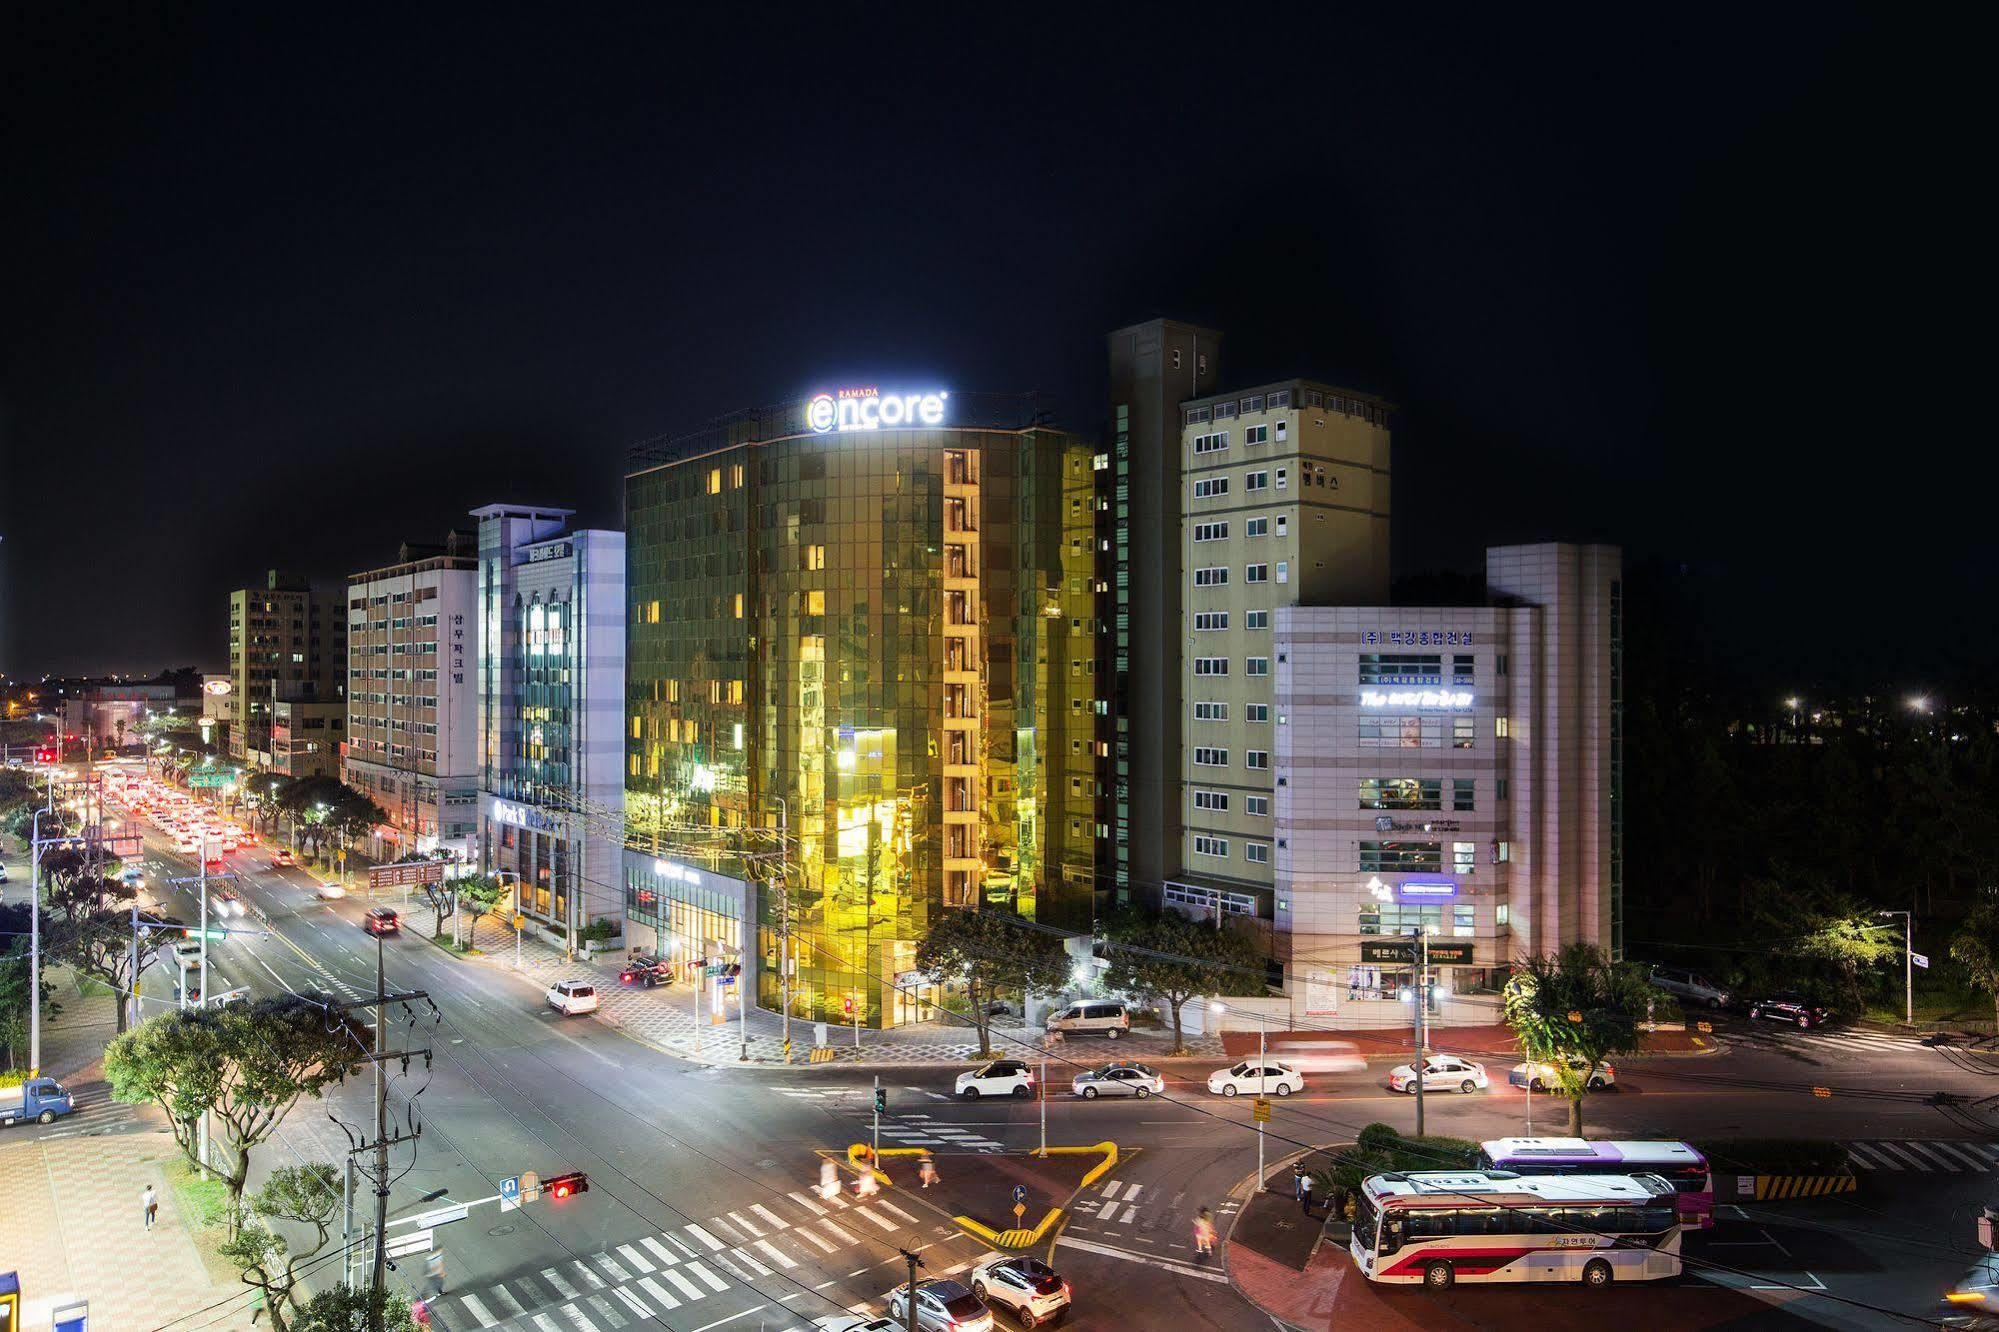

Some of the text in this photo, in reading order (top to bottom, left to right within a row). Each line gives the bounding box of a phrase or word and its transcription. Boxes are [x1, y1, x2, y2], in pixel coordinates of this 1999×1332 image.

[838, 388, 878, 398] RAMADA
[1361, 631, 1473, 646] (주) 백강종합건설
